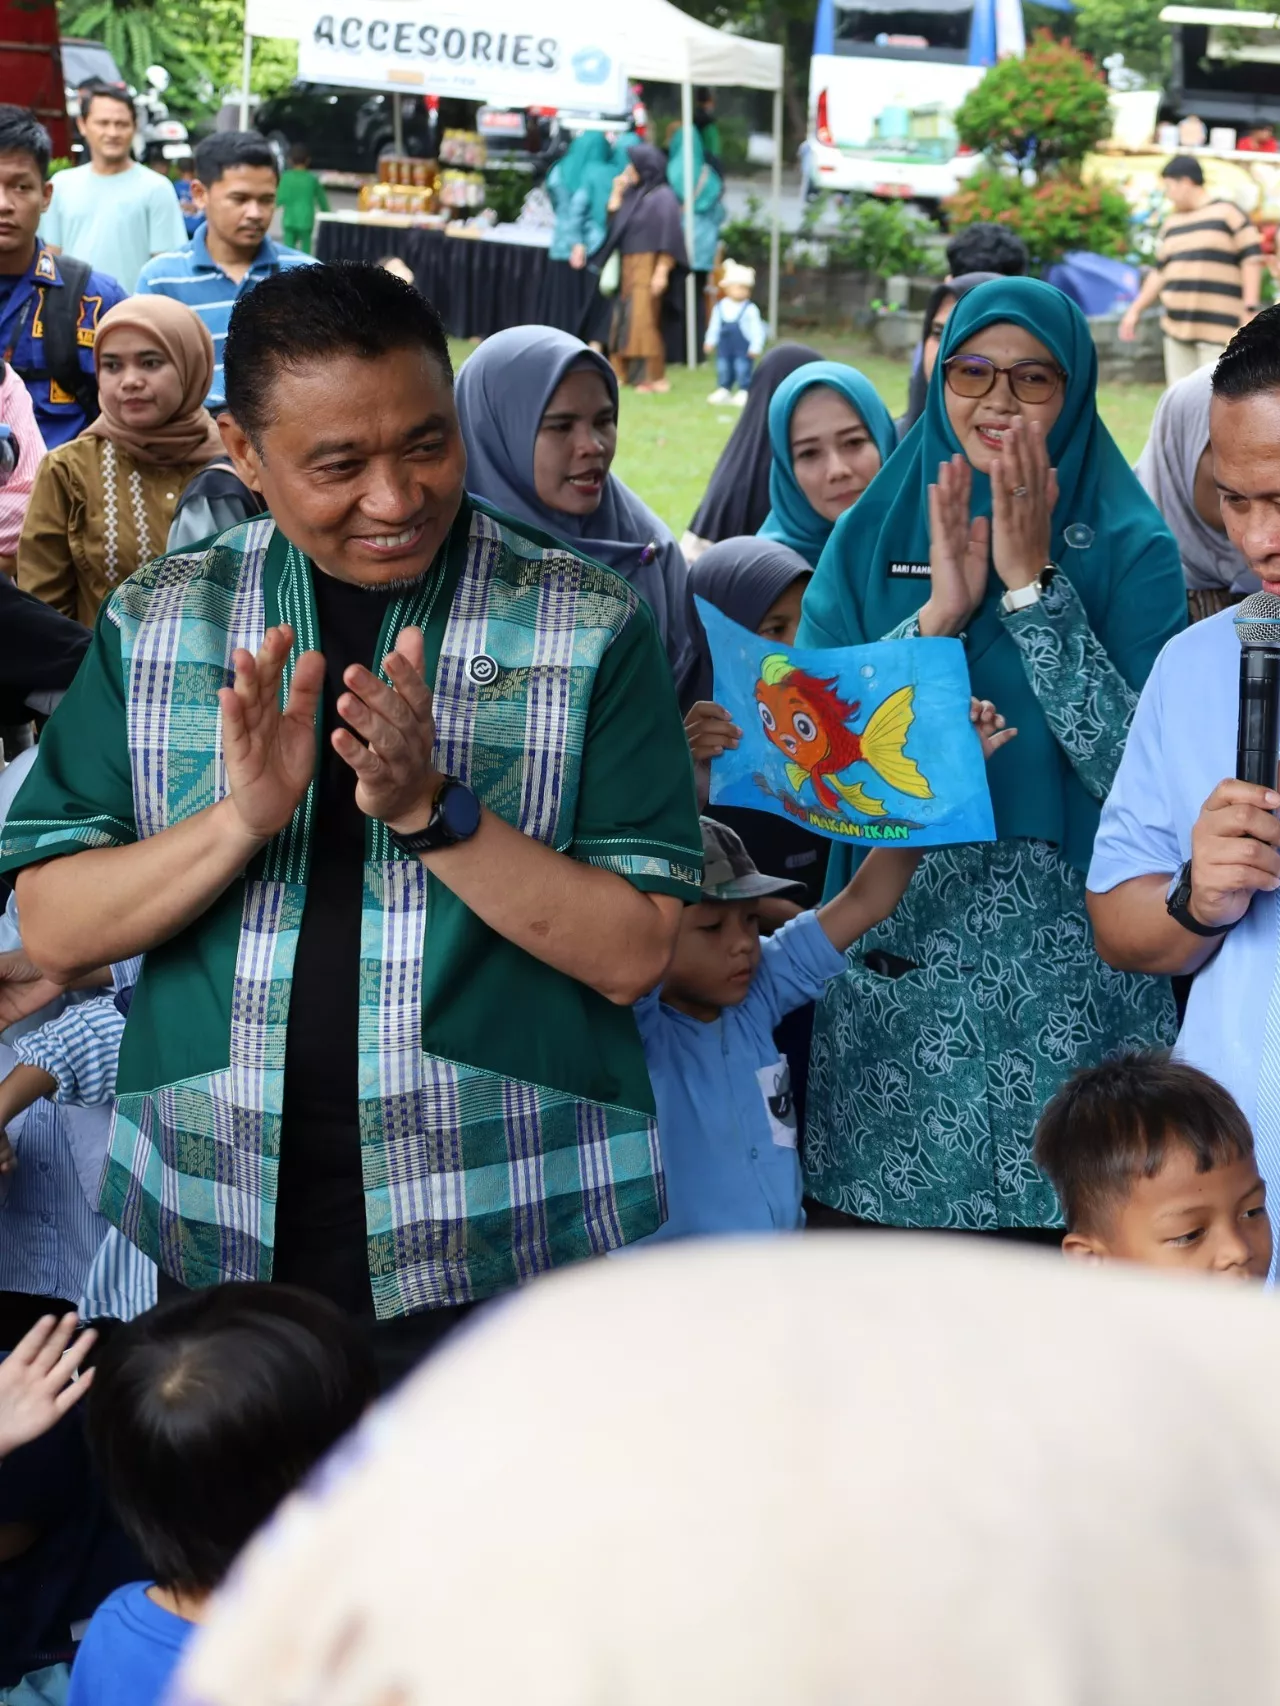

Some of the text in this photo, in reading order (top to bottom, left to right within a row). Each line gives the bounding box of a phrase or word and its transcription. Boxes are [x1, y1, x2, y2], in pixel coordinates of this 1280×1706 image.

[314, 14, 558, 69] ACCESORIES
[891, 564, 910, 574] SARI
[808, 812, 910, 840] MAKAN IKAN
